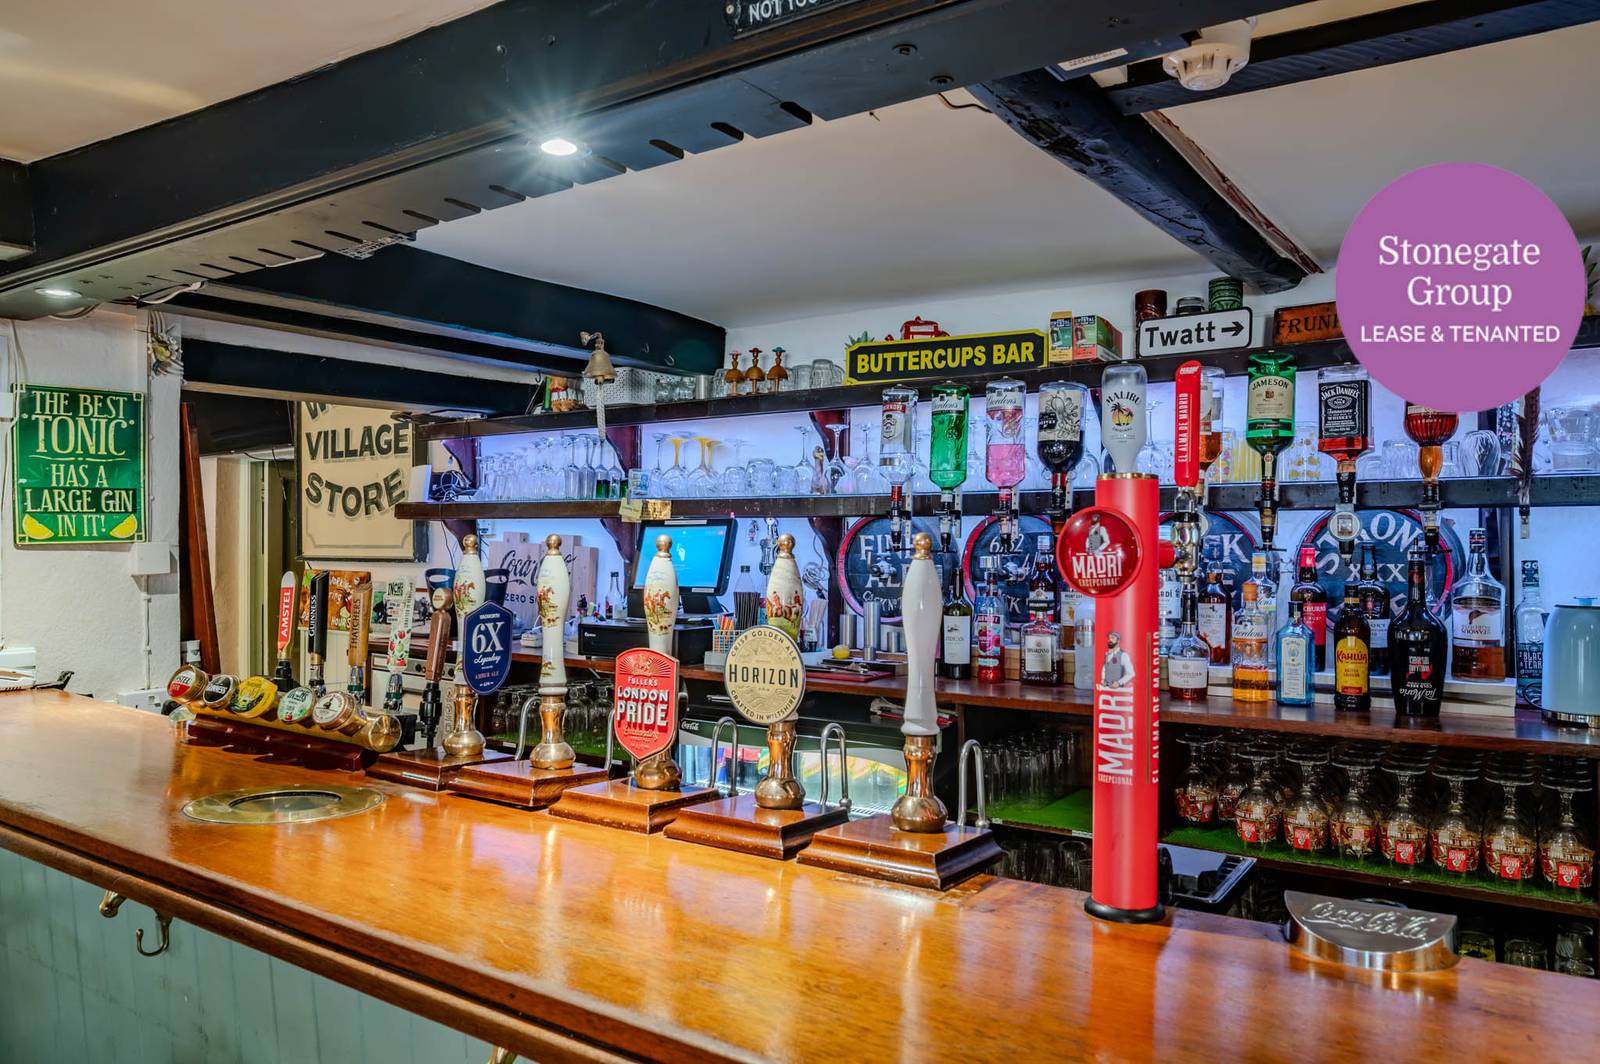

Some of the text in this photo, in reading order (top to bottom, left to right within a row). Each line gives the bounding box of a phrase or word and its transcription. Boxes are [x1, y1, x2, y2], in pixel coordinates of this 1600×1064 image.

[1145, 321, 1216, 348] Twatt
[857, 341, 1035, 374] BUTTERCUPS BAR
[1106, 391, 1140, 406] MALIBU
[1252, 379, 1288, 390] JAMESON
[1321, 388, 1336, 400] JACK
[32, 390, 128, 421] THE BEST
[33, 415, 129, 456] TONIC
[305, 421, 410, 461] VILLAGE
[51, 463, 109, 488] HAS A
[25, 488, 134, 513] LARGE GIN
[305, 468, 408, 520] STORE
[58, 515, 106, 538] IN IT!
[281, 589, 291, 638] AMSTEL
[309, 594, 317, 637] GUINNESS
[350, 599, 361, 649] THATCHERS
[472, 621, 505, 653] 6X
[731, 630, 797, 661] CRISP GOLDEN ALE
[729, 664, 798, 688] HORIZON
[617, 686, 669, 702] LONDON
[731, 689, 797, 721] CRAFTED IN WILTSHIRE
[616, 701, 668, 727] PRIDE
